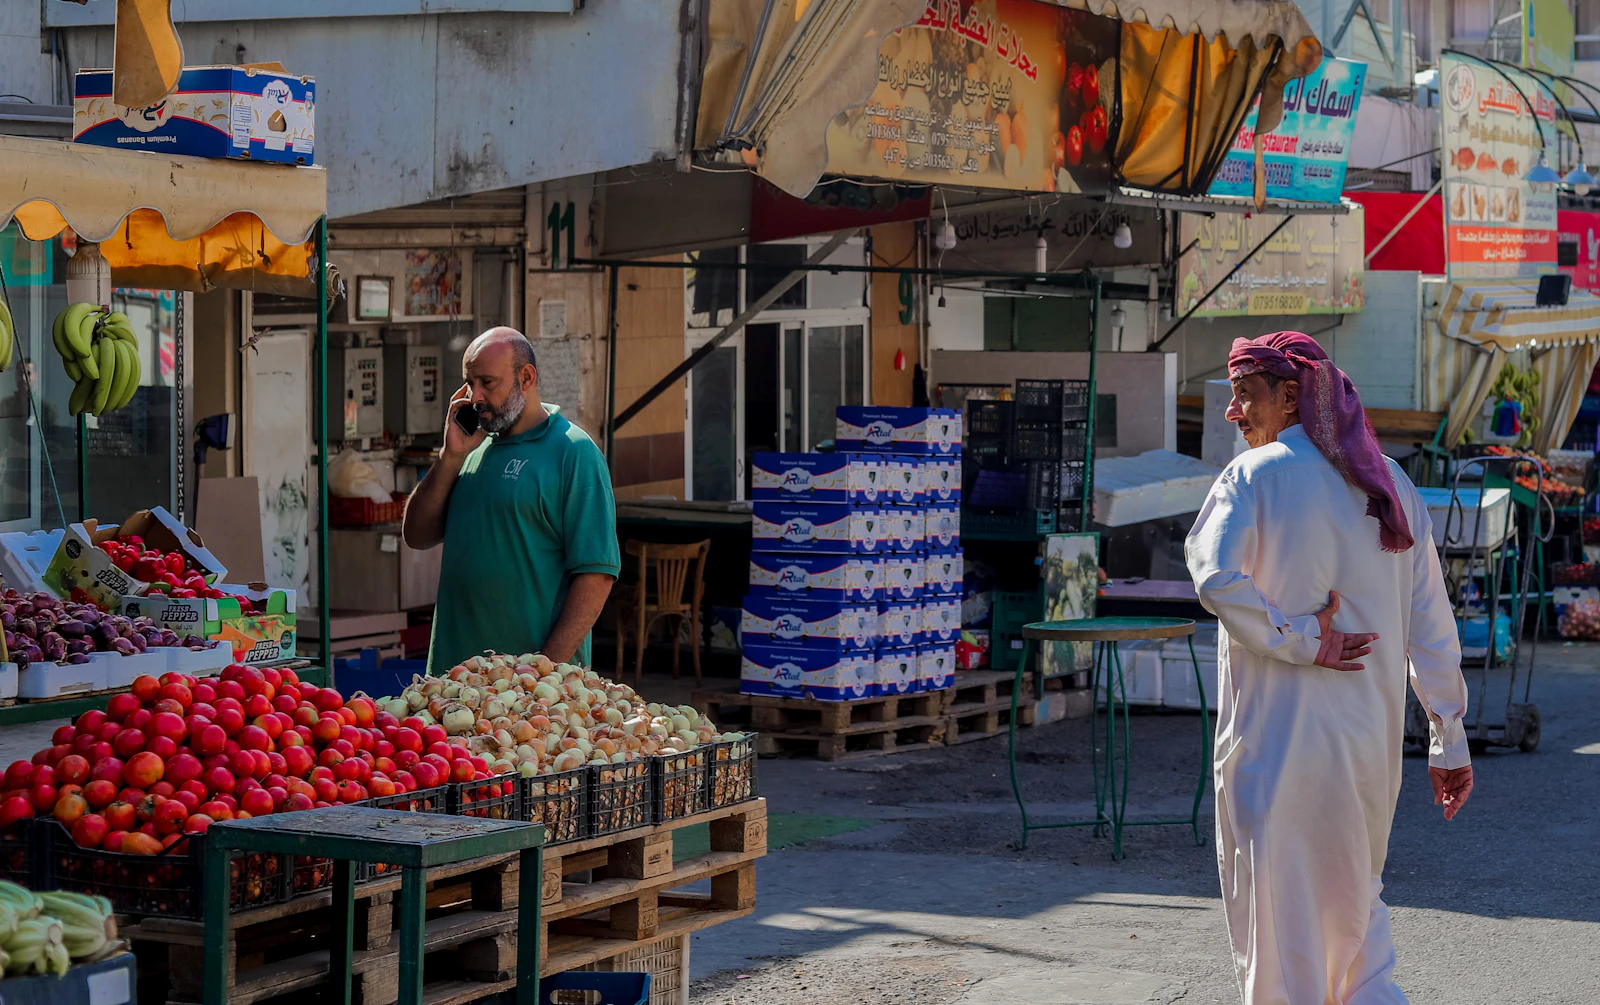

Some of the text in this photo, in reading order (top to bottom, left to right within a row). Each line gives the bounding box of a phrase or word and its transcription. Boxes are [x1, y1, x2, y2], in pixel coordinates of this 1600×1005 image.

[950, 0, 996, 49] العقبة
[996, 23, 1040, 83] محلات
[899, 60, 937, 94] الخضار
[962, 77, 992, 106] جميع
[1307, 74, 1360, 118] أسماك
[864, 103, 894, 120] ومطاعم
[894, 106, 916, 122] فنادق
[117, 136, 177, 144] Premium Bananas
[867, 123, 901, 141] 2013684
[884, 148, 899, 164] 447
[547, 202, 576, 270] 11
[898, 271, 913, 326] 9
[97, 571, 128, 595] PEPPER
[106, 570, 127, 586] FRESH
[161, 611, 198, 622] PEPPER
[168, 605, 191, 613] FRESH
[255, 641, 275, 650] FRESH
[247, 648, 280, 662] PEPPER
